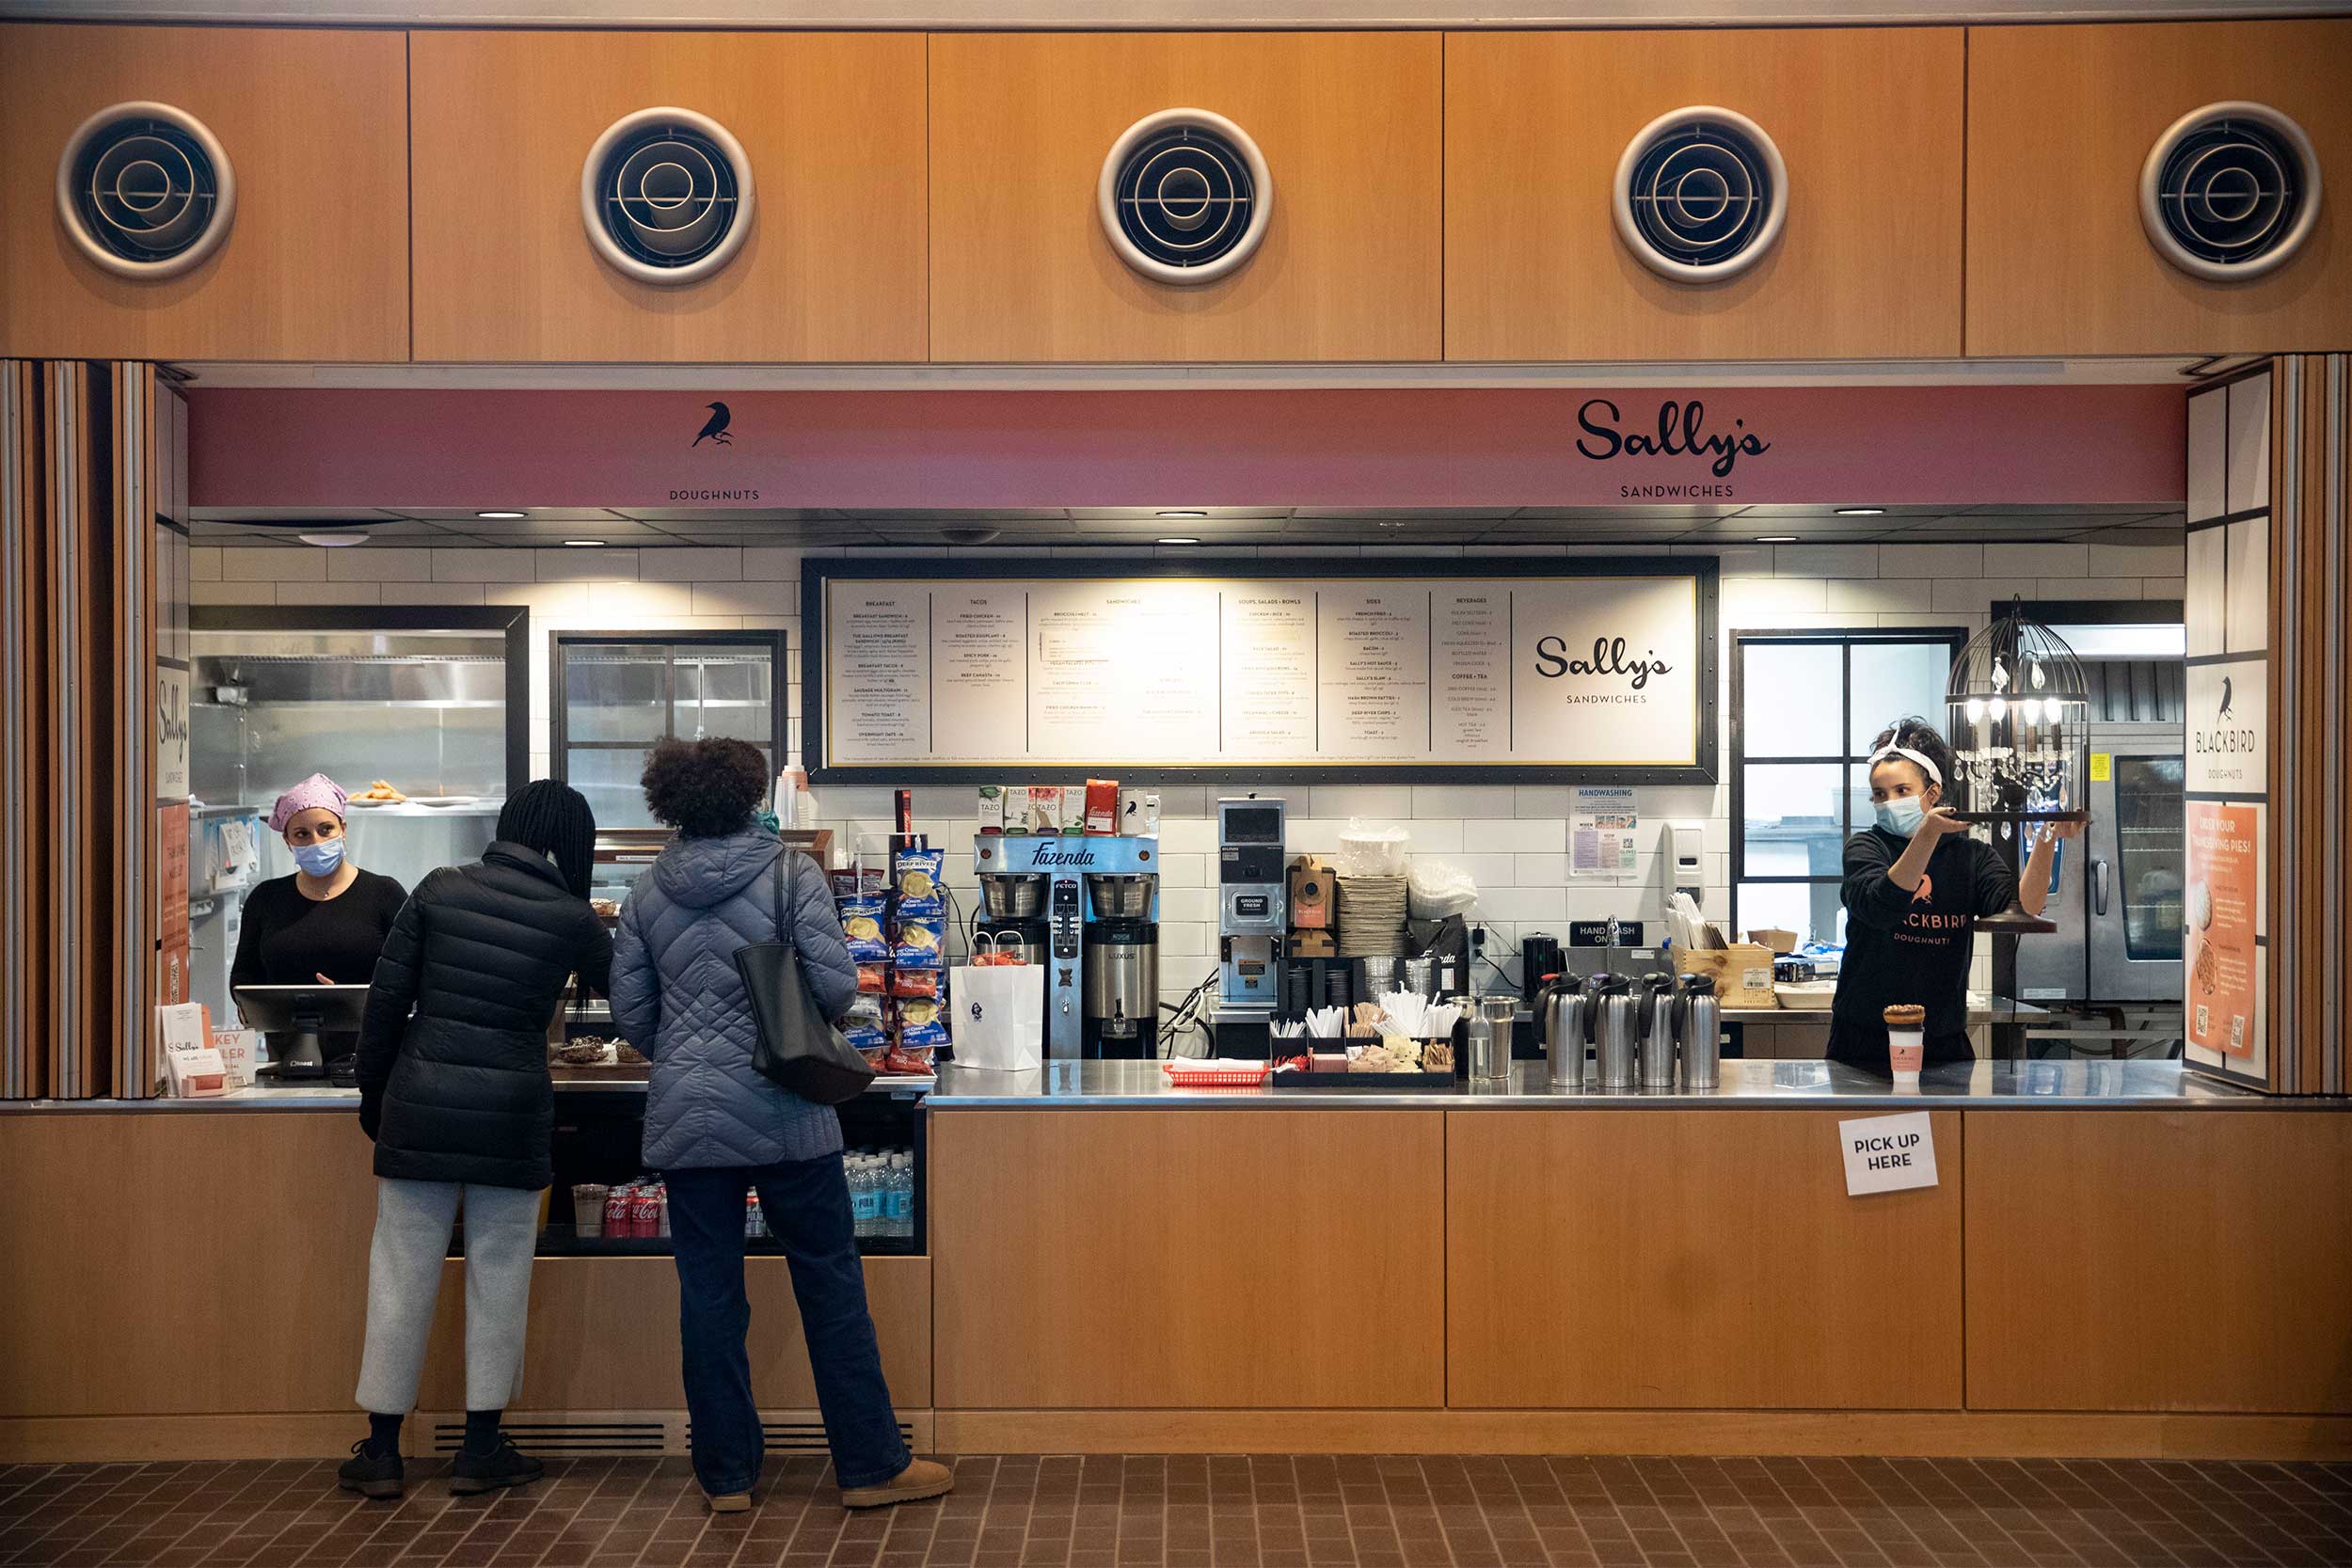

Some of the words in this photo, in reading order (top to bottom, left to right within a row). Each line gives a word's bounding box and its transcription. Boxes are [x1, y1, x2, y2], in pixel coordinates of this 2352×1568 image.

[1576, 399, 1771, 477] Sally's
[670, 490, 759, 500] DOUGHNUTS
[1621, 485, 1733, 498] SANDWICHES
[1534, 636, 1673, 689] Sally's
[1566, 694, 1646, 704] SANDWICHES
[159, 679, 187, 763] Sally's
[2196, 729, 2255, 753] BLACKBIRD
[2208, 768, 2243, 780] DOUGHNUTS
[1032, 841, 1095, 865] Fazenda
[2231, 840, 2250, 853] PIES!
[1581, 927, 1606, 935] HAND
[1617, 927, 1635, 935] ASH
[1595, 935, 1609, 943] ON
[215, 1033, 241, 1045] KEY
[1854, 1136, 1894, 1153] PICK
[1898, 1133, 1920, 1148] UP
[1867, 1152, 1912, 1170] HERE
